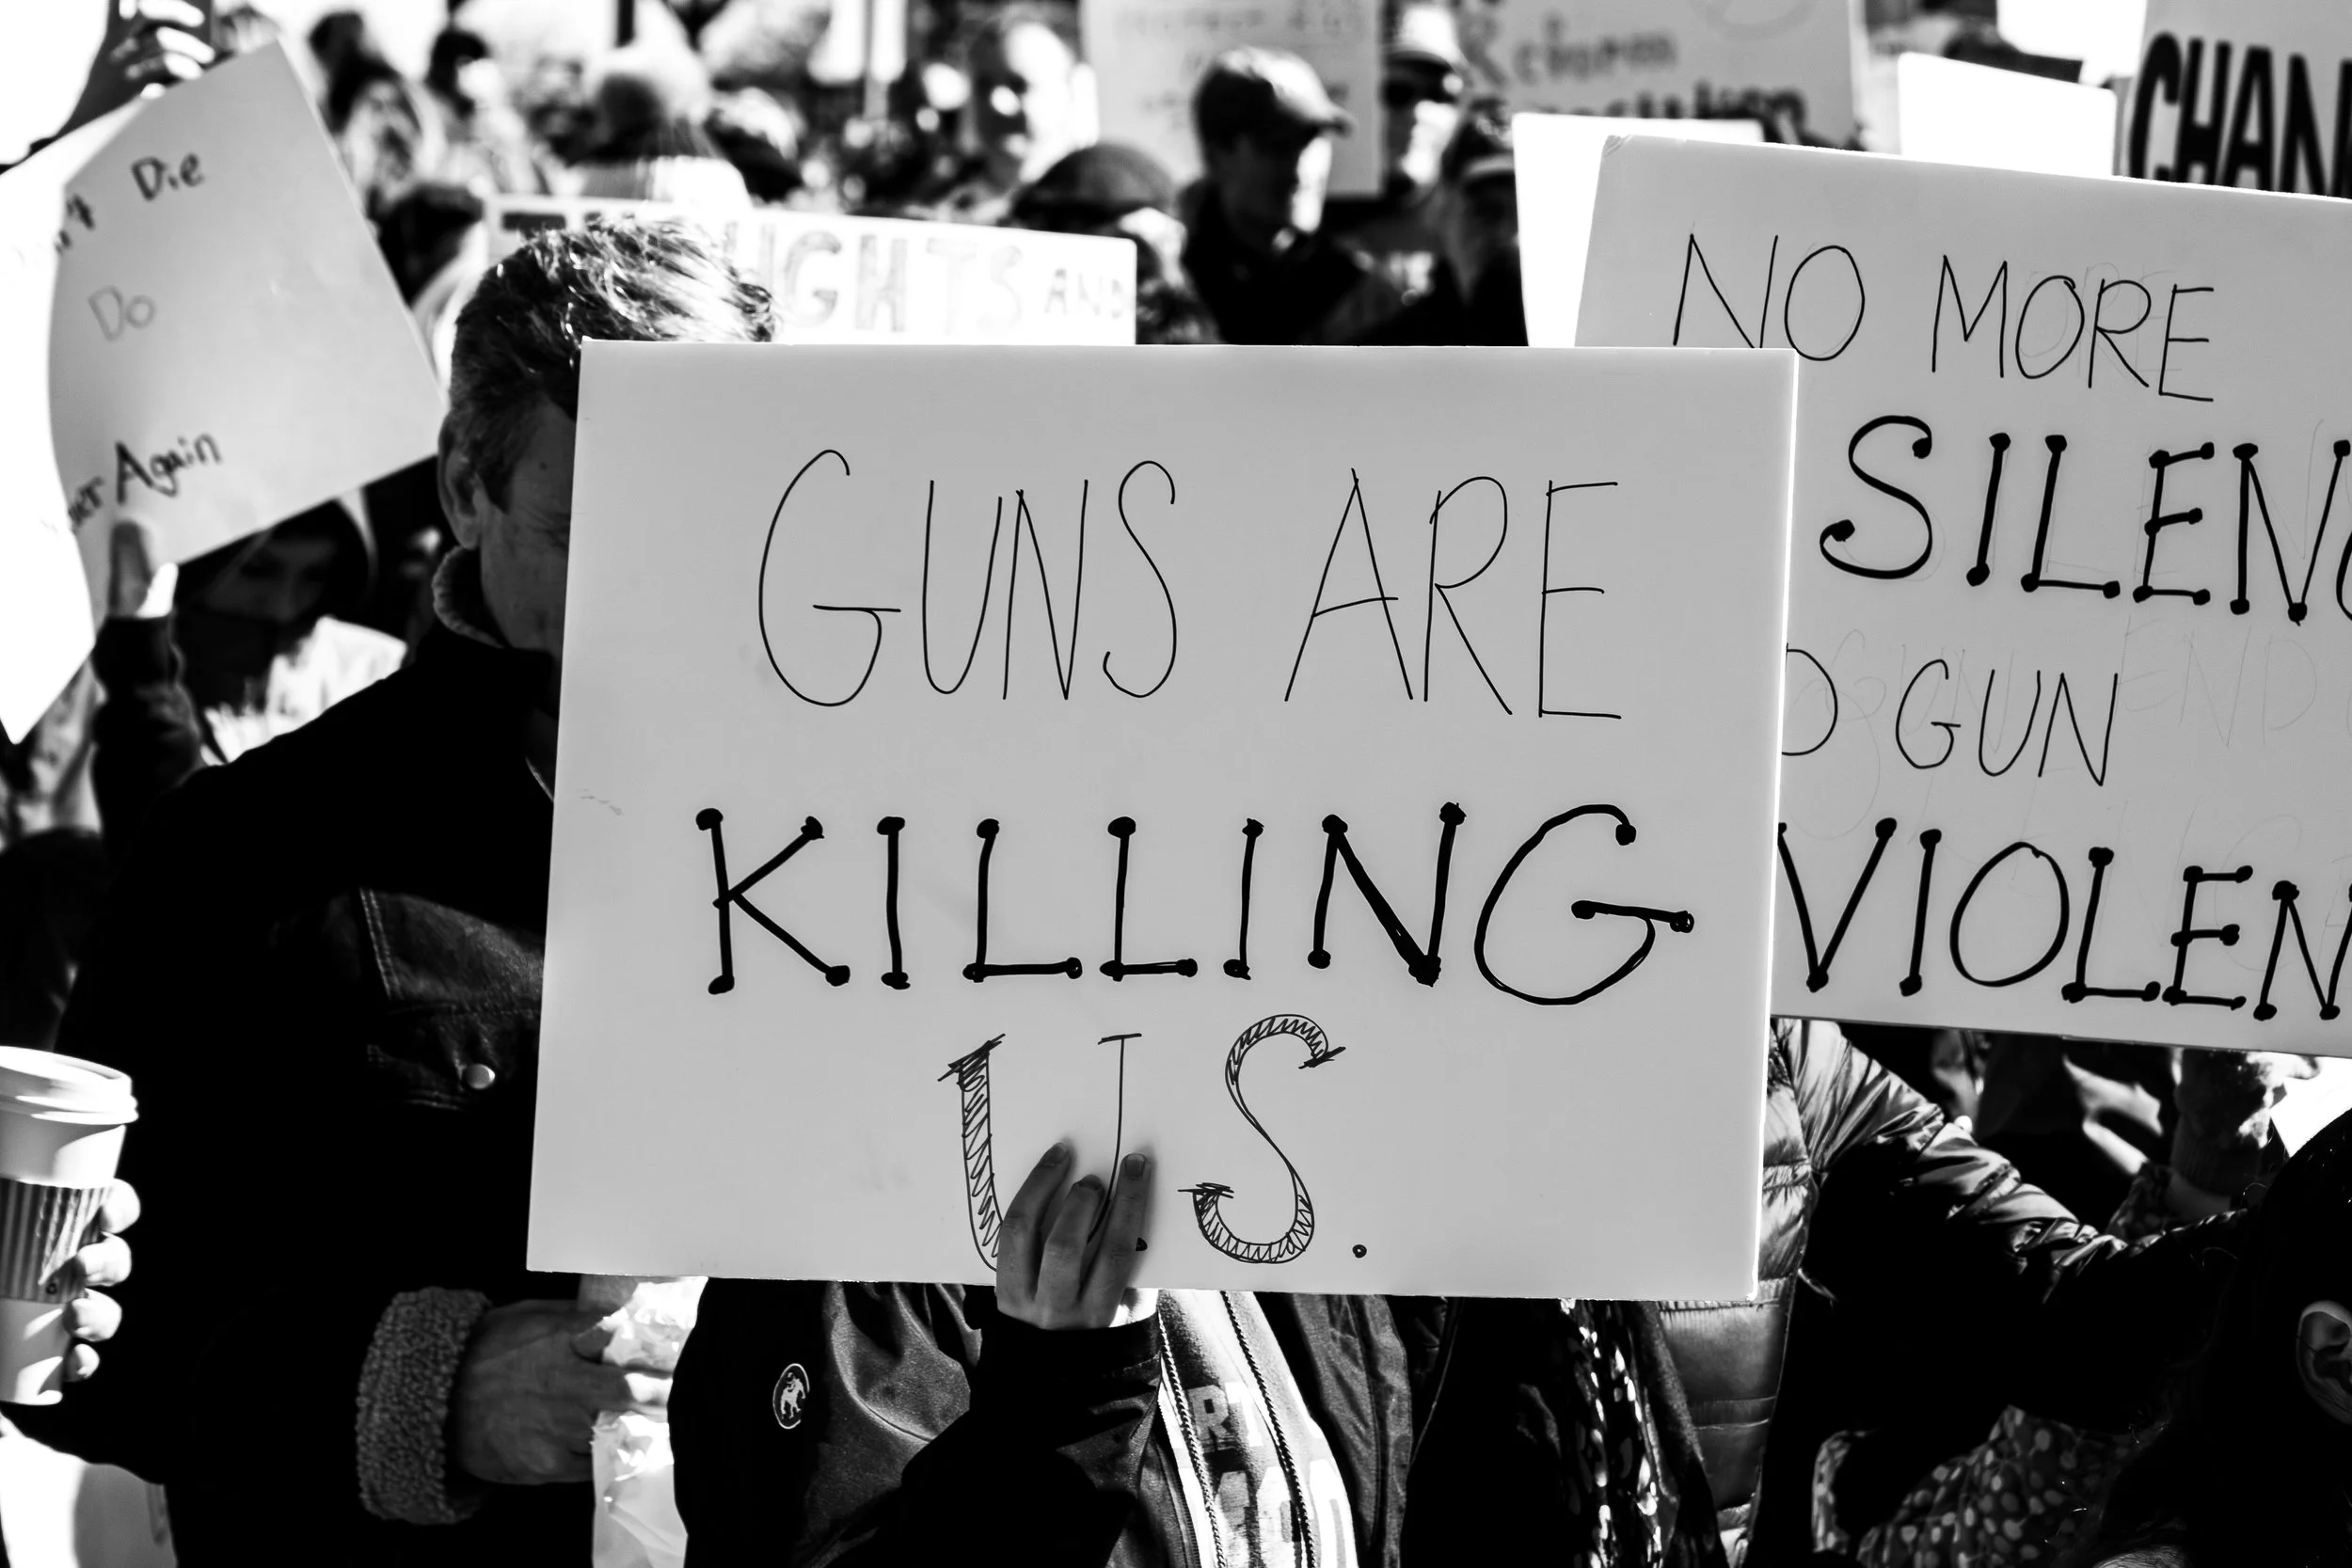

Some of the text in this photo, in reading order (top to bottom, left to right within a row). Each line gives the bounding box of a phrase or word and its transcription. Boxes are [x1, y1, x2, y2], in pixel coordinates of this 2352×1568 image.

[129, 151, 206, 203] Die
[87, 284, 157, 342] Do
[1672, 231, 2215, 403] NO MORE
[114, 432, 224, 508] Again
[1819, 415, 2352, 626] SILEN
[757, 449, 1622, 721] GUNS ARE
[1895, 658, 2121, 786] GUN
[695, 801, 1695, 1006] KILLING
[1777, 816, 2352, 1022] VIOLEN
